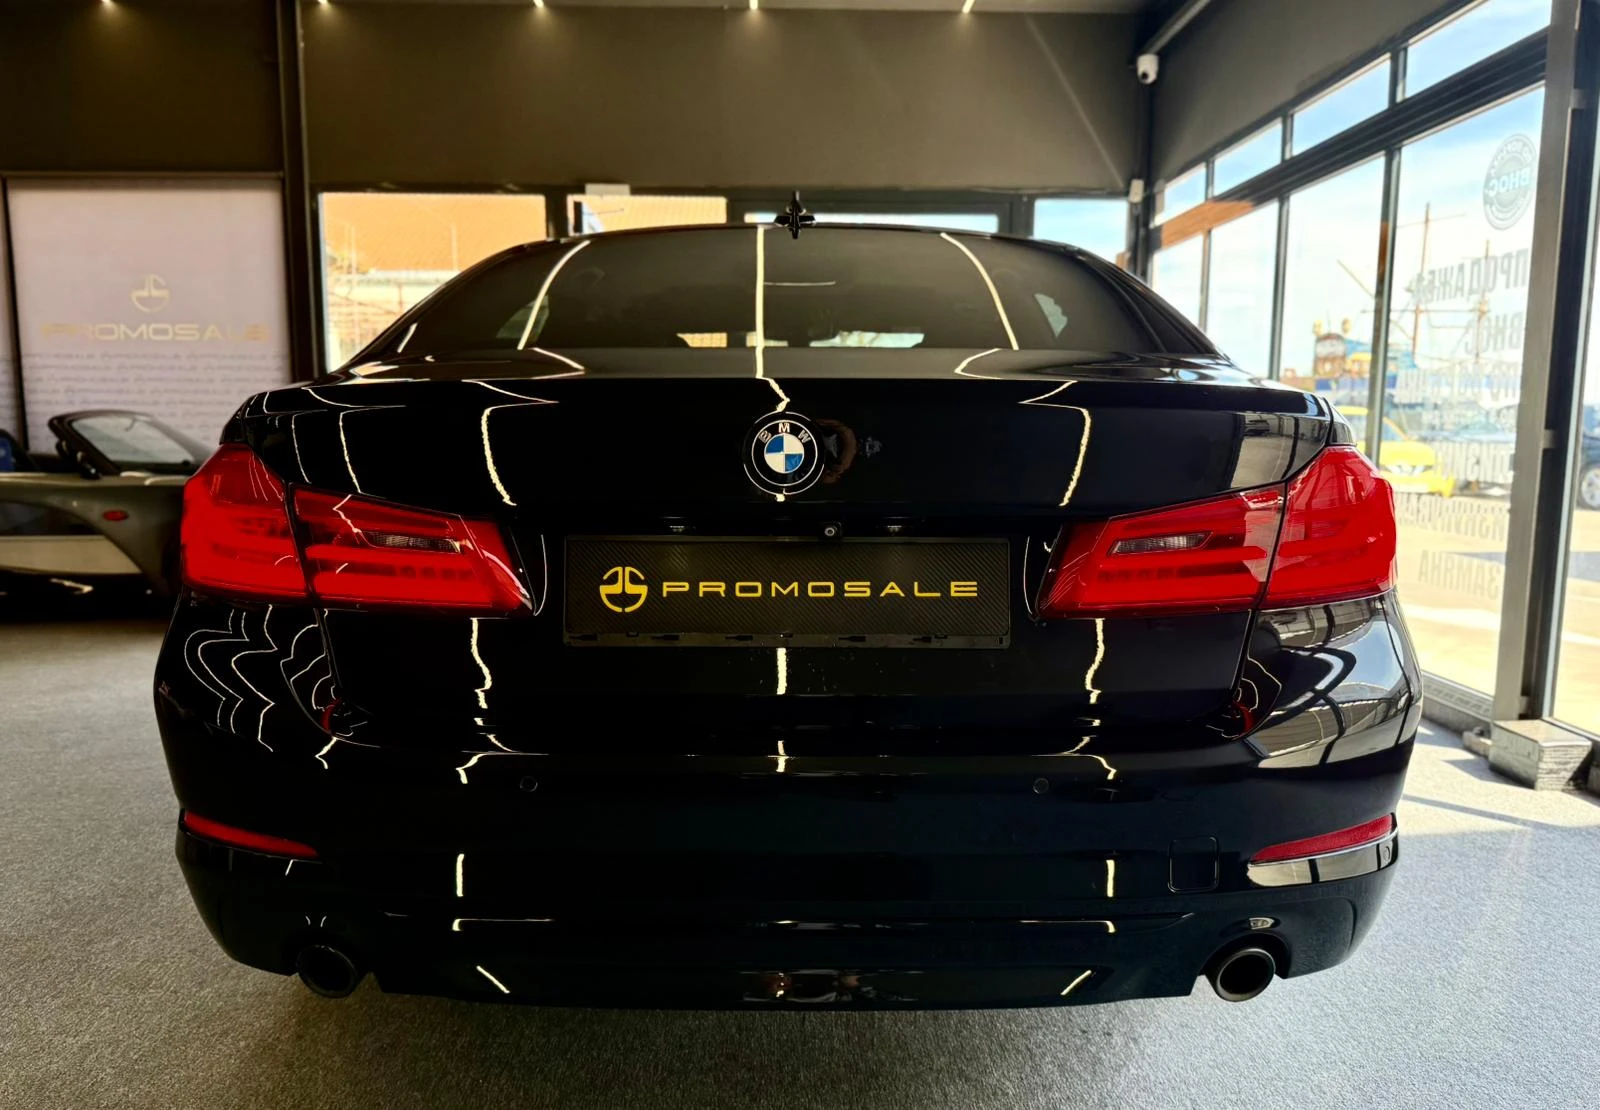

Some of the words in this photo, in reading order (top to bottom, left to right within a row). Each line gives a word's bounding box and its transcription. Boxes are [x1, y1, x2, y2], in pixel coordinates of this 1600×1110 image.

[40, 323, 270, 342] PROMOSALE
[759, 421, 811, 443] BMW
[662, 581, 978, 597] PROMOSALE
